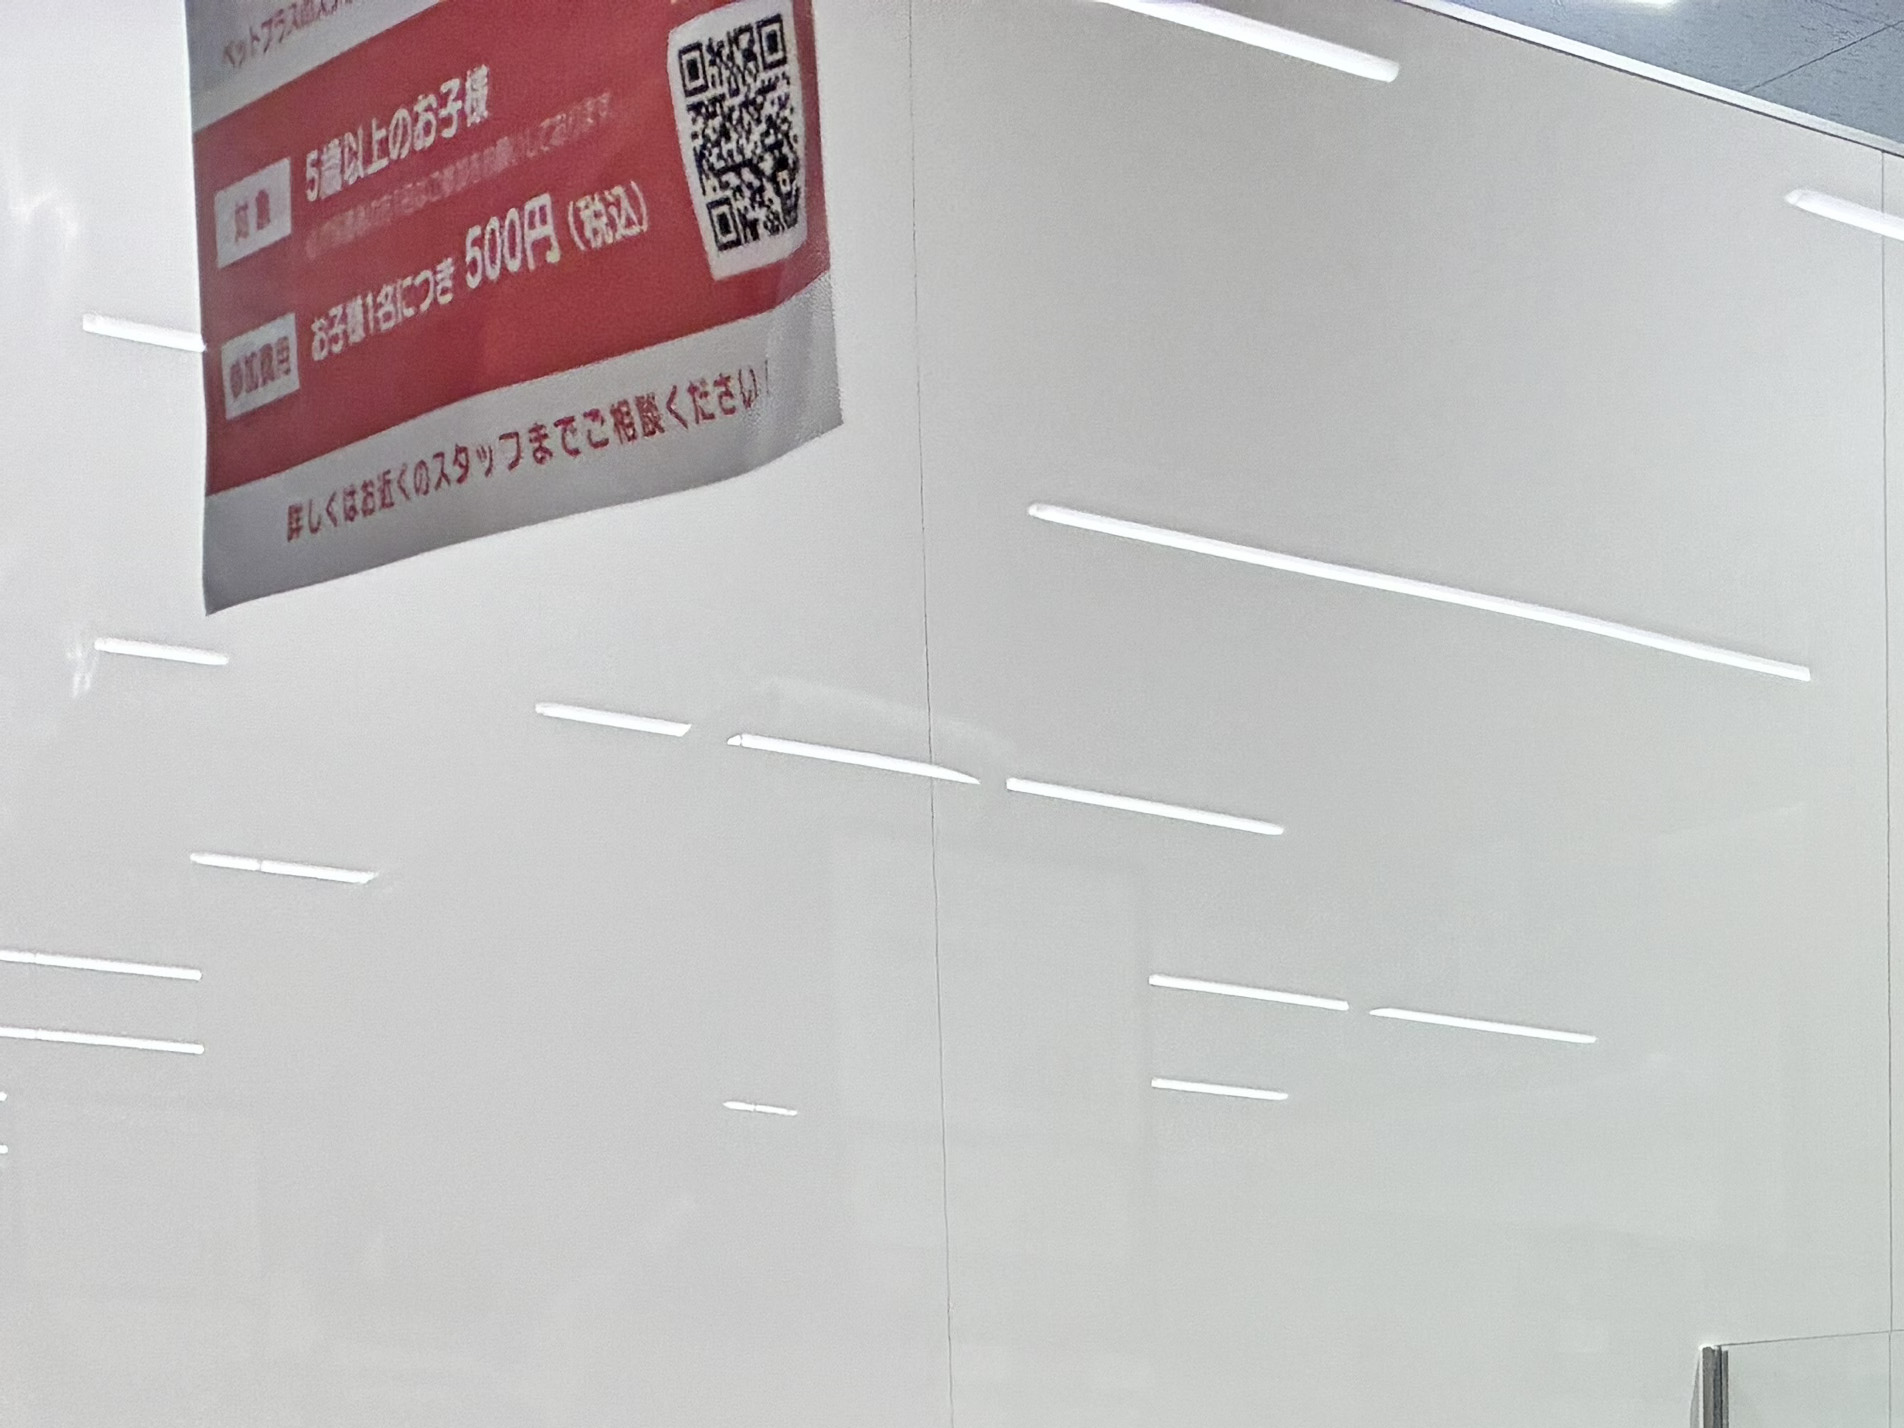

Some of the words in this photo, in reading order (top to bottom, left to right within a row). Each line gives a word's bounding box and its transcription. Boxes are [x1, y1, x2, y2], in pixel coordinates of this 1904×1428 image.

[304, 62, 490, 202] 5歳以上のお子様
[310, 257, 457, 362] お子様1名につき
[464, 192, 561, 291] 500円
[567, 180, 649, 254] (税込)
